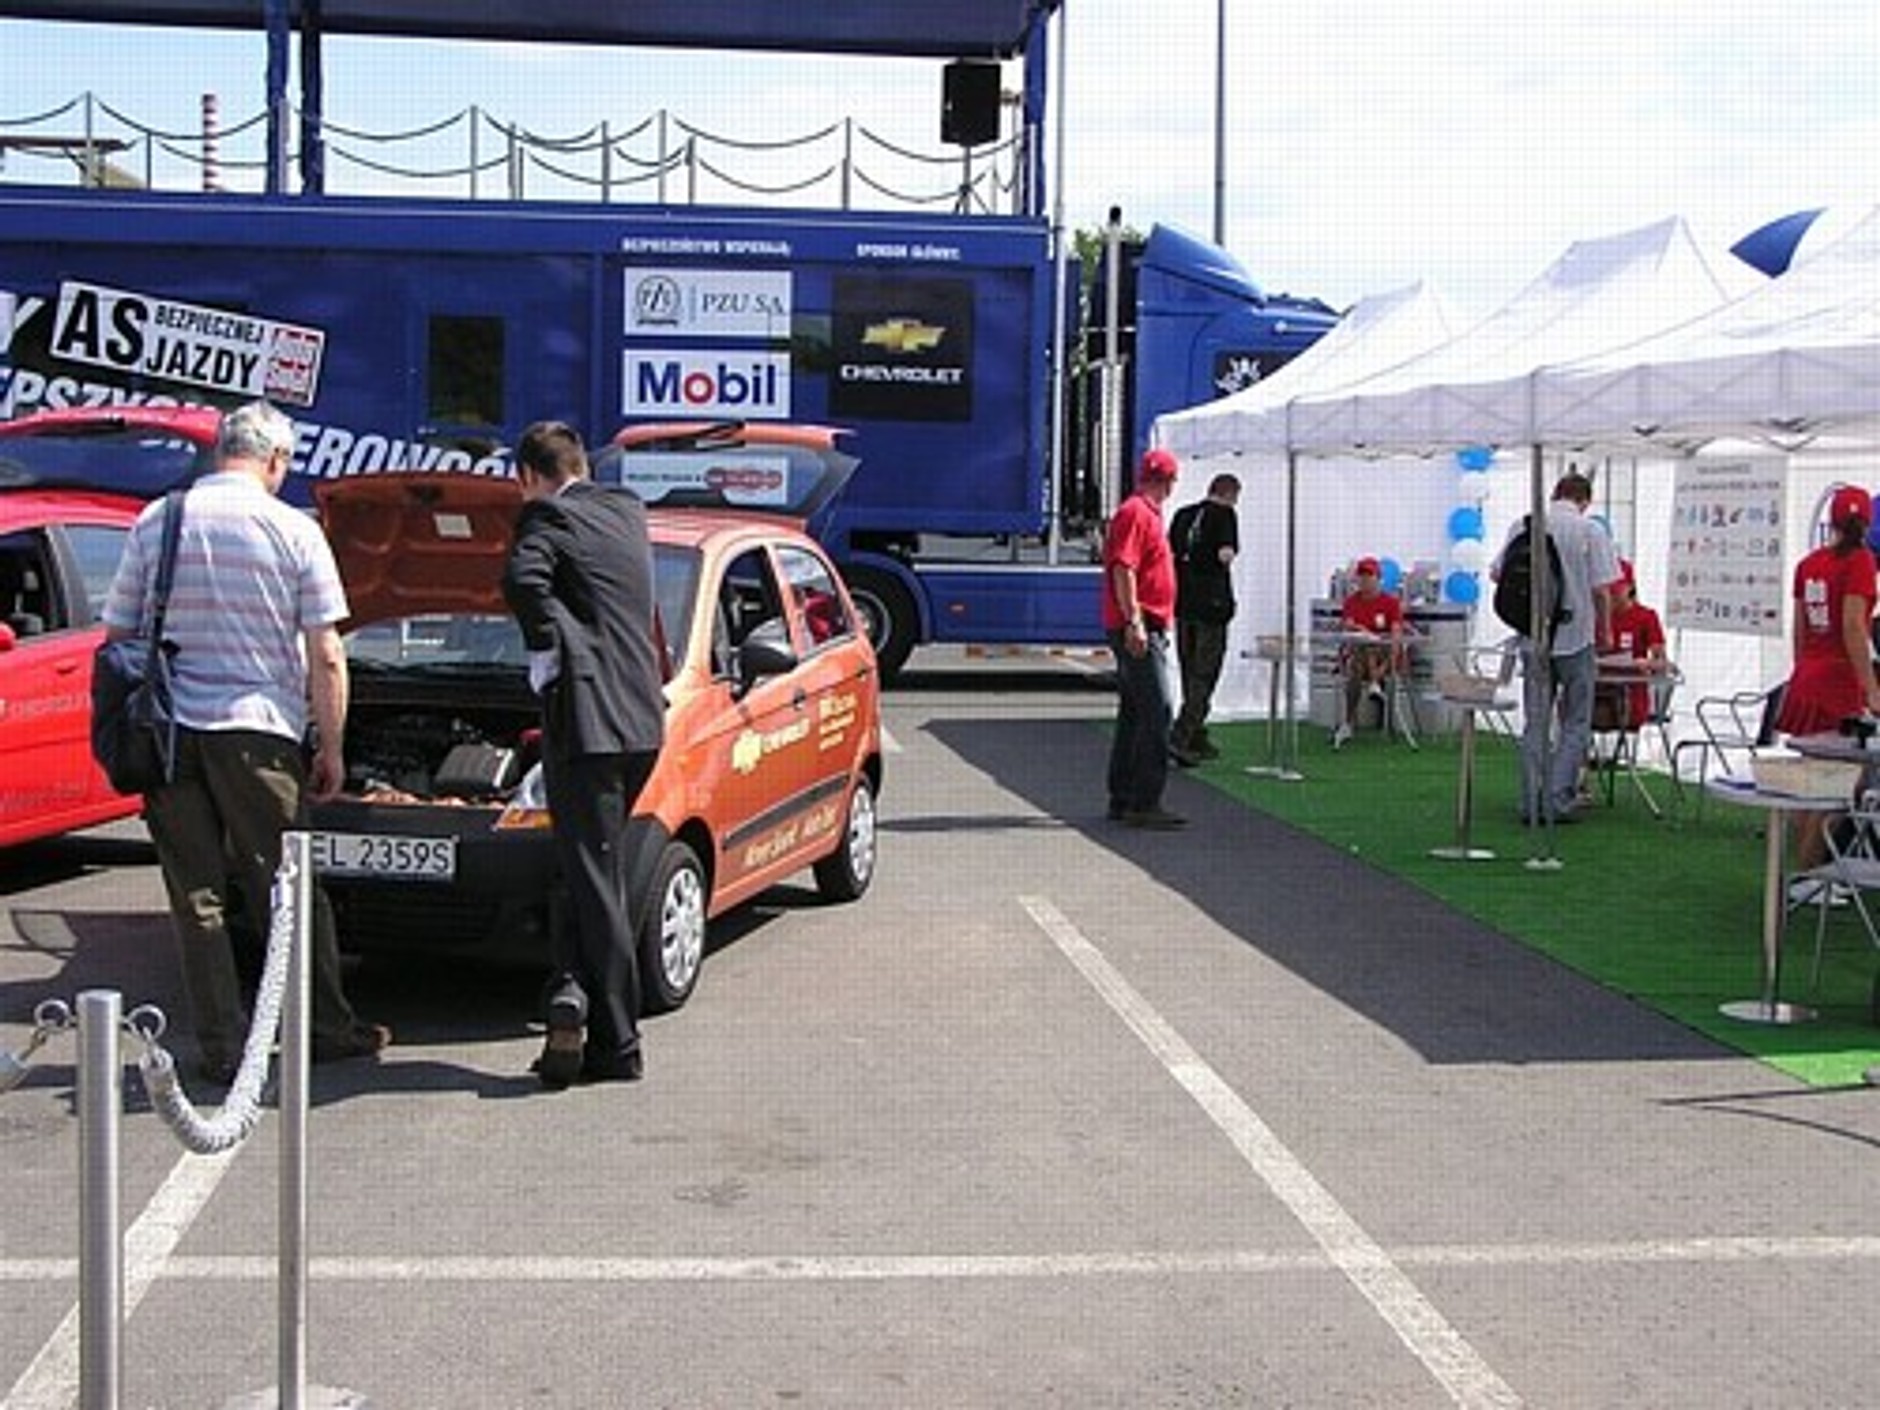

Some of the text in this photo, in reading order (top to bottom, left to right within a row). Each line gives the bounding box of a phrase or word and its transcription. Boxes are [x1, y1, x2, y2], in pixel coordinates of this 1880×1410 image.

[154, 303, 265, 344] BEZPIECZNEJ
[702, 293, 786, 315] PZU SA
[56, 289, 148, 366] AS
[145, 337, 261, 389] JAZDY
[842, 364, 964, 384] CHEVROLET
[638, 362, 776, 406] Mobil
[358, 838, 450, 874] 2359S
